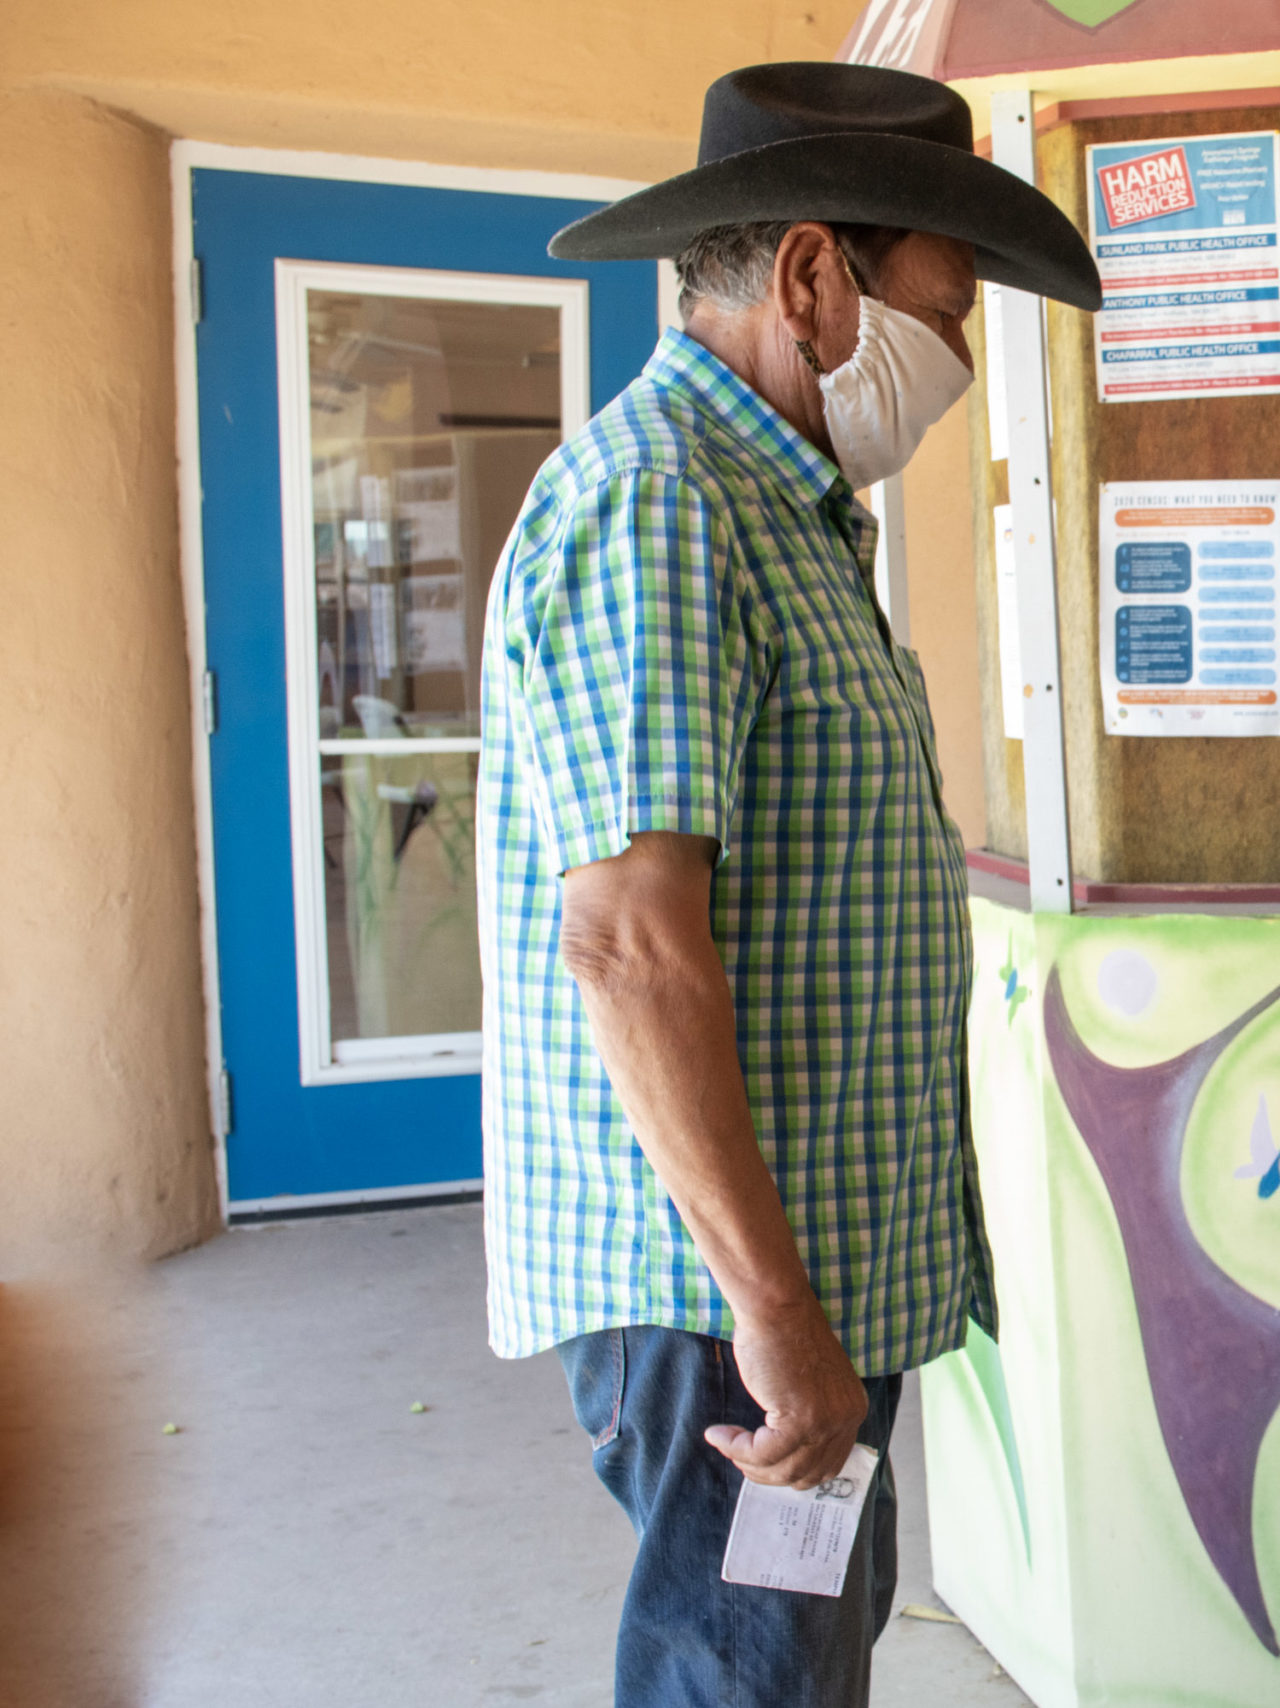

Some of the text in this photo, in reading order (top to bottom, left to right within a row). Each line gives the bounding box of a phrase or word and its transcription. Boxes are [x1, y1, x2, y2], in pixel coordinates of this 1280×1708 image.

[1105, 154, 1184, 195] HARM
[1111, 178, 1187, 208] REDUCTION
[1113, 192, 1190, 224] SERVICES
[1101, 235, 1268, 257] SUNLAND PARK PUBLIC HEALTH OFFICE
[1104, 290, 1248, 309] ANTHONY PUBLIC HEALTH OFFICE
[1106, 343, 1259, 362] CHAPARRAL PUBLIC HEALTH OFFICE
